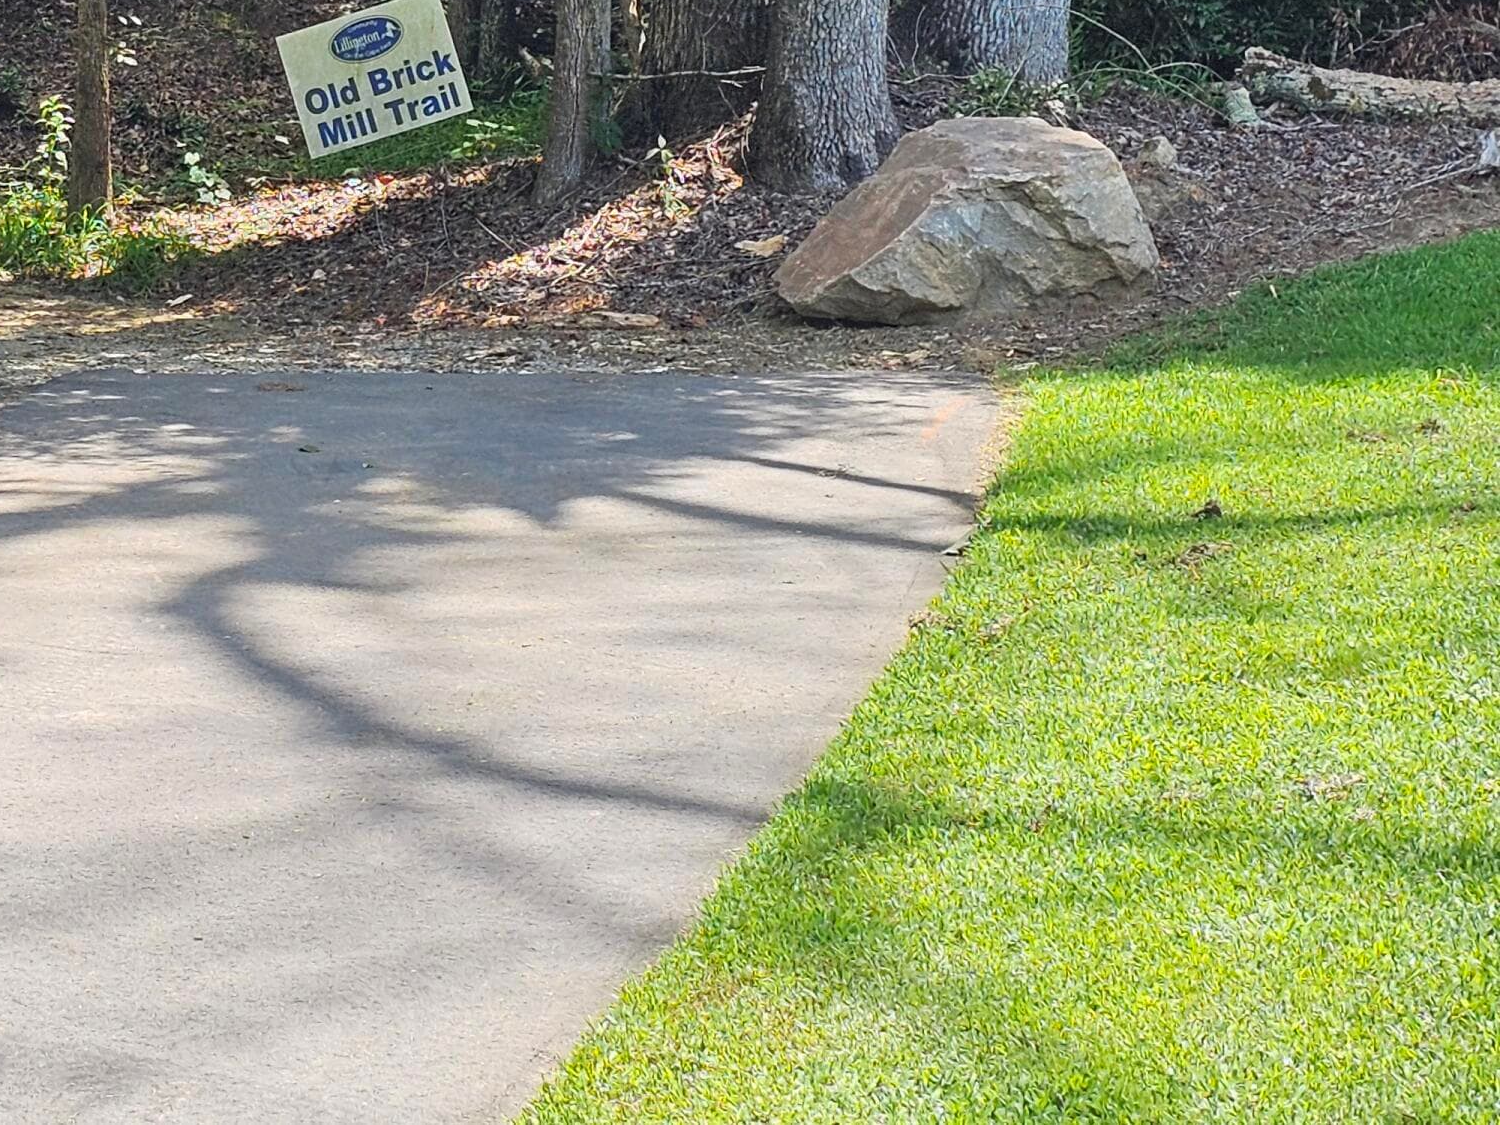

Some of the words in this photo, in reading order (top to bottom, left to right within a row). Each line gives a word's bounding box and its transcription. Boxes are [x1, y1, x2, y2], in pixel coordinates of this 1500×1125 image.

[334, 31, 380, 54] Lillington
[304, 77, 361, 115] Old
[367, 50, 457, 96] Brick
[317, 108, 378, 149] Mill
[384, 82, 461, 126] Trail
